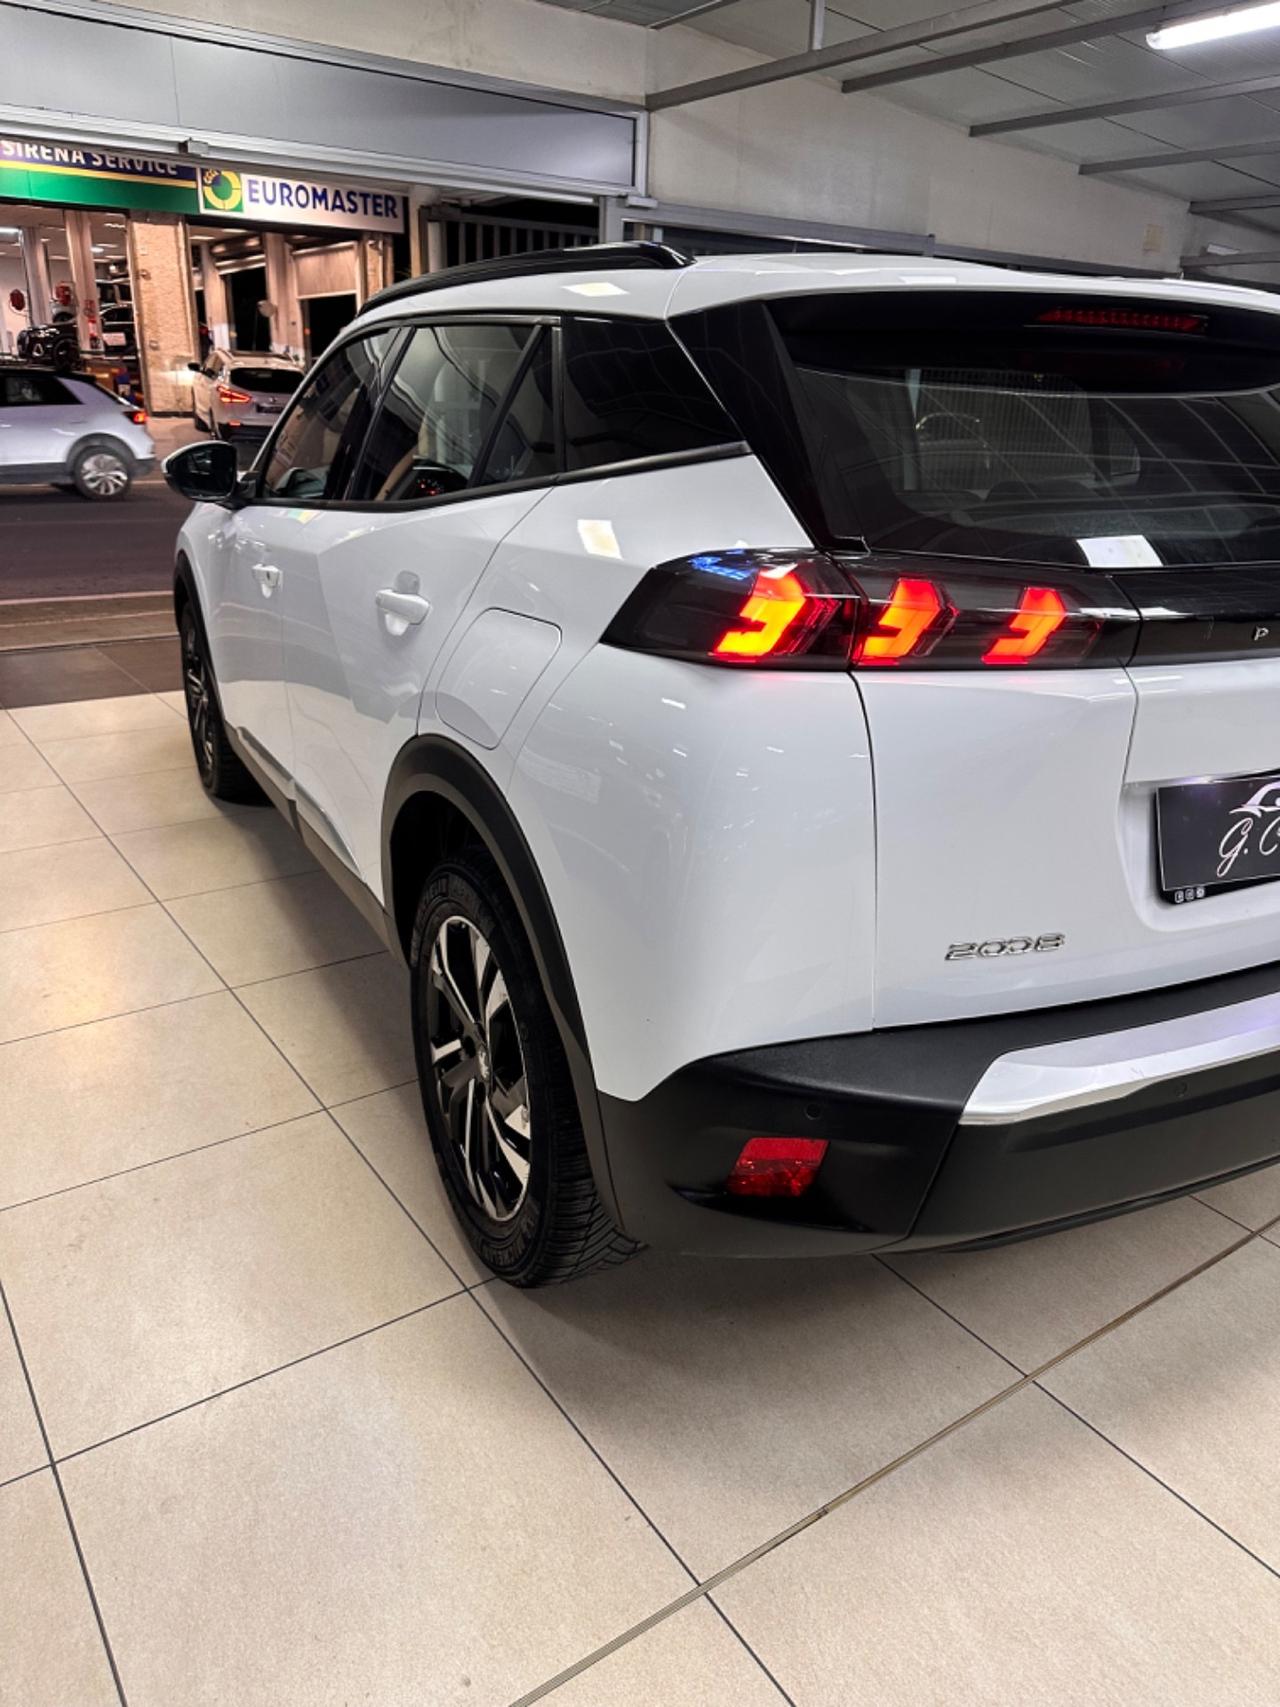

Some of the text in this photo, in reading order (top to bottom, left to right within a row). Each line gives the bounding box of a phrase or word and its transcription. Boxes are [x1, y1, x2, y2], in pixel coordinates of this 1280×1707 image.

[1, 140, 178, 176] SIRENA SERVICE
[248, 179, 399, 219] EUROMASTER
[944, 932, 1065, 961] 2008
